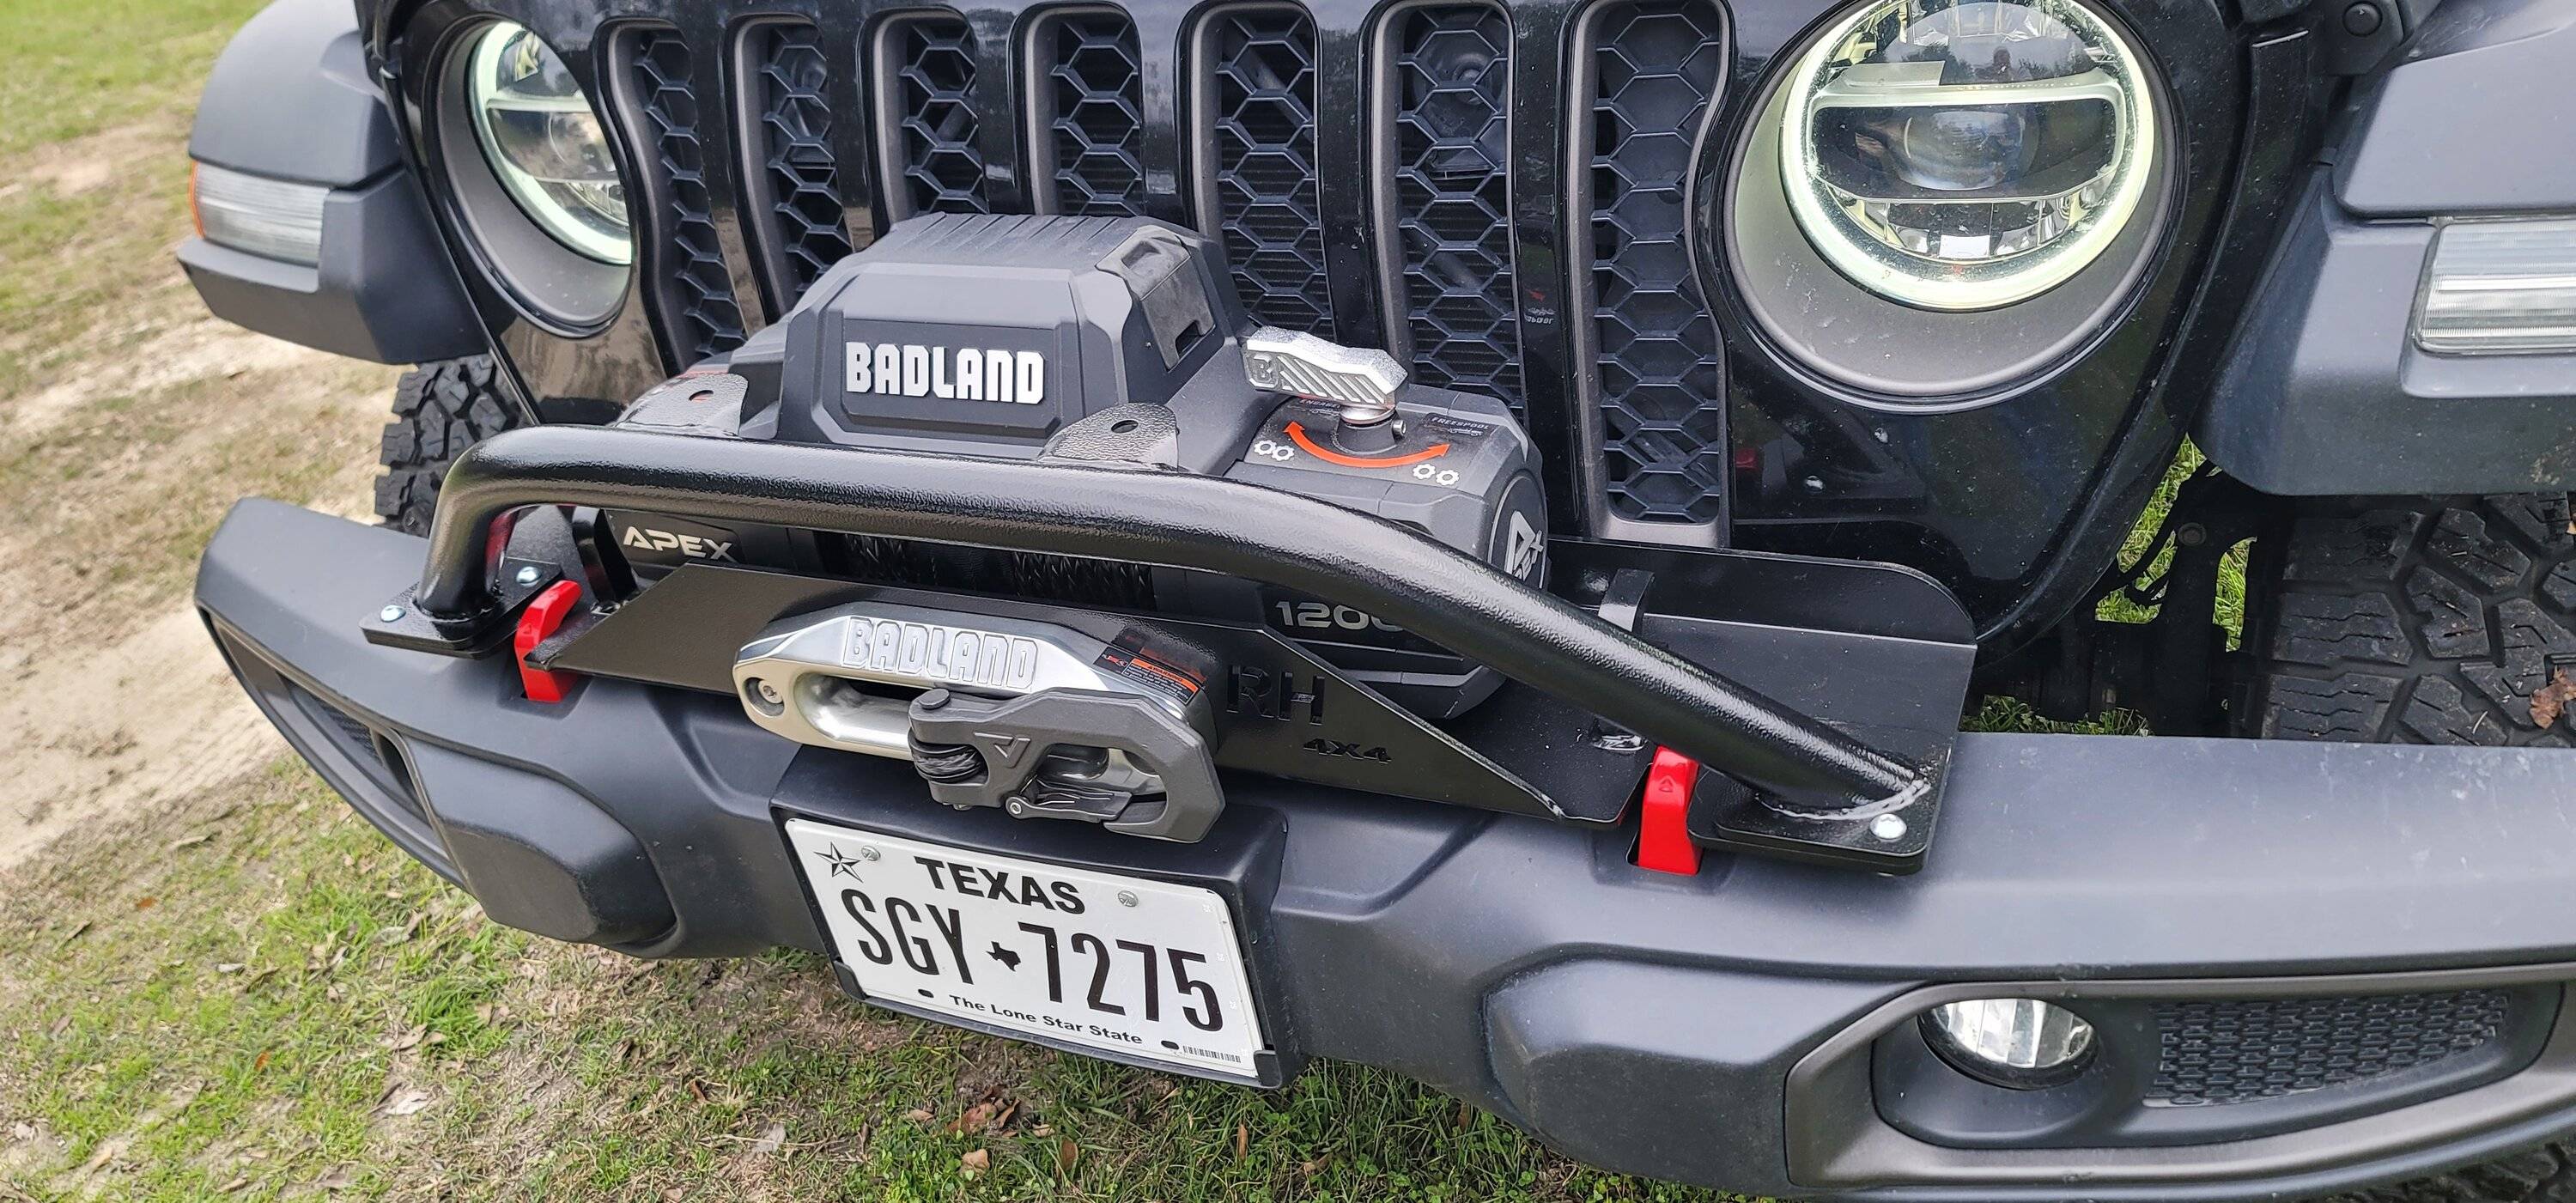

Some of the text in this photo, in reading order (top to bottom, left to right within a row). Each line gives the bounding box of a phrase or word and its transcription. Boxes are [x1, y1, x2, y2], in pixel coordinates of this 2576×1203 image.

[846, 342, 1044, 404] BADLAND
[623, 526, 735, 562] APEX
[842, 616, 1039, 690] BADLAND
[914, 856, 1085, 914] TEXAS
[841, 889, 1224, 1032] SGY 7275
[950, 994, 1143, 1045] The Lone Star State
